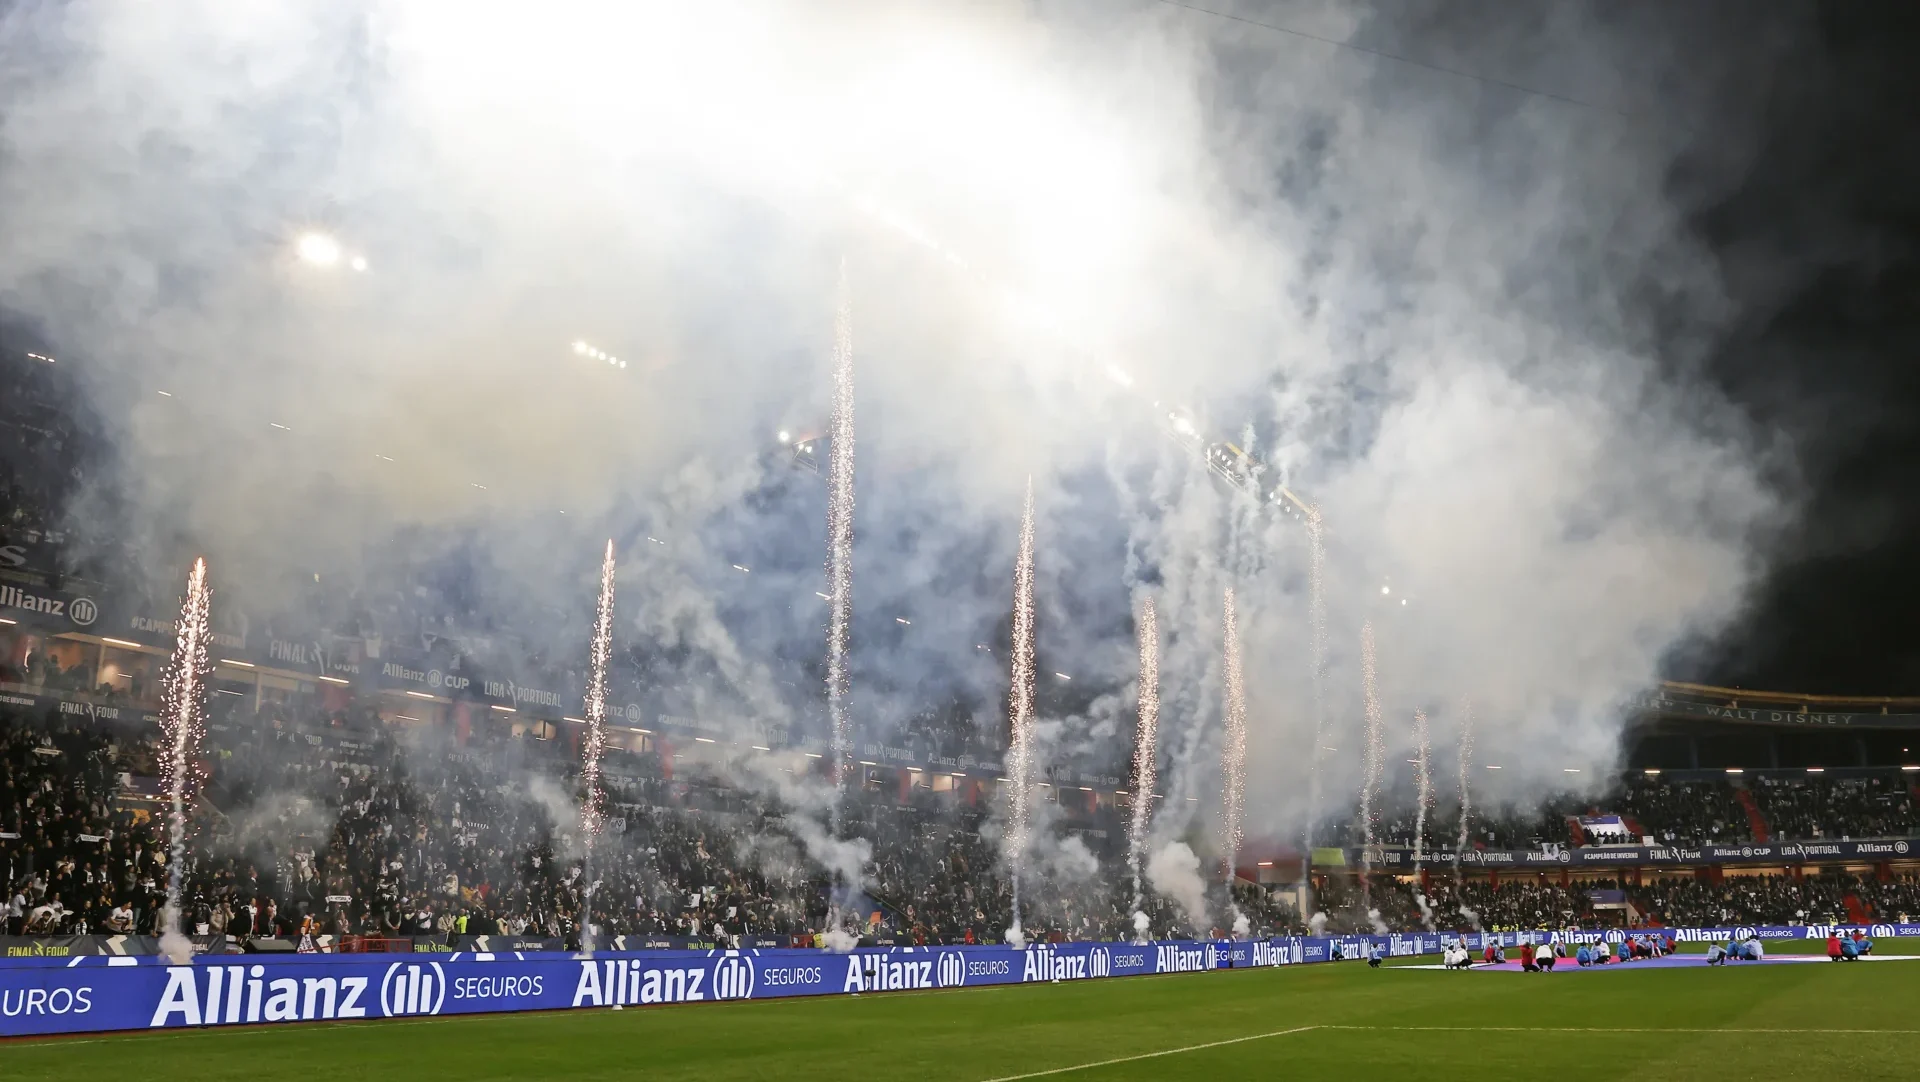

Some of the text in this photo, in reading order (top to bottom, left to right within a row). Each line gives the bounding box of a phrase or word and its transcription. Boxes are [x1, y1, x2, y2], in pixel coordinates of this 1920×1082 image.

[269, 640, 307, 664] FINAL
[383, 663, 470, 689] Allianz CUP
[484, 681, 562, 707] LIGA PORTUGAL
[60, 702, 119, 719] FINAL FOUR
[1706, 707, 1758, 720] WALT
[1771, 712, 1852, 724] DISNEY
[864, 744, 879, 756] LIGA
[886, 748, 915, 761] PORTUGAL
[1650, 850, 1671, 860] FINAL
[1714, 848, 1771, 856] Allianz CUP
[1781, 845, 1841, 856] LIGA PORTUGAL
[1857, 843, 1893, 853] Allianz
[1386, 852, 1400, 862] FOUR
[1441, 853, 1455, 861] CUP
[1463, 853, 1513, 862] LIGA PORTUGAL
[1675, 928, 1731, 941] Allianz
[8, 946, 69, 957] FINAL FOUR
[1253, 942, 1323, 966] Allianz SEGUROS
[1390, 936, 1413, 956] Allianz
[1023, 949, 1144, 981] Allianz SEGUROS
[1156, 945, 1202, 972] Allianz
[844, 953, 1009, 992] Allianz SEGUROS
[572, 960, 821, 1007] Allianz SEGUROS
[3, 987, 93, 1016] UROS
[150, 965, 543, 1026] Allianz SEGUROS
